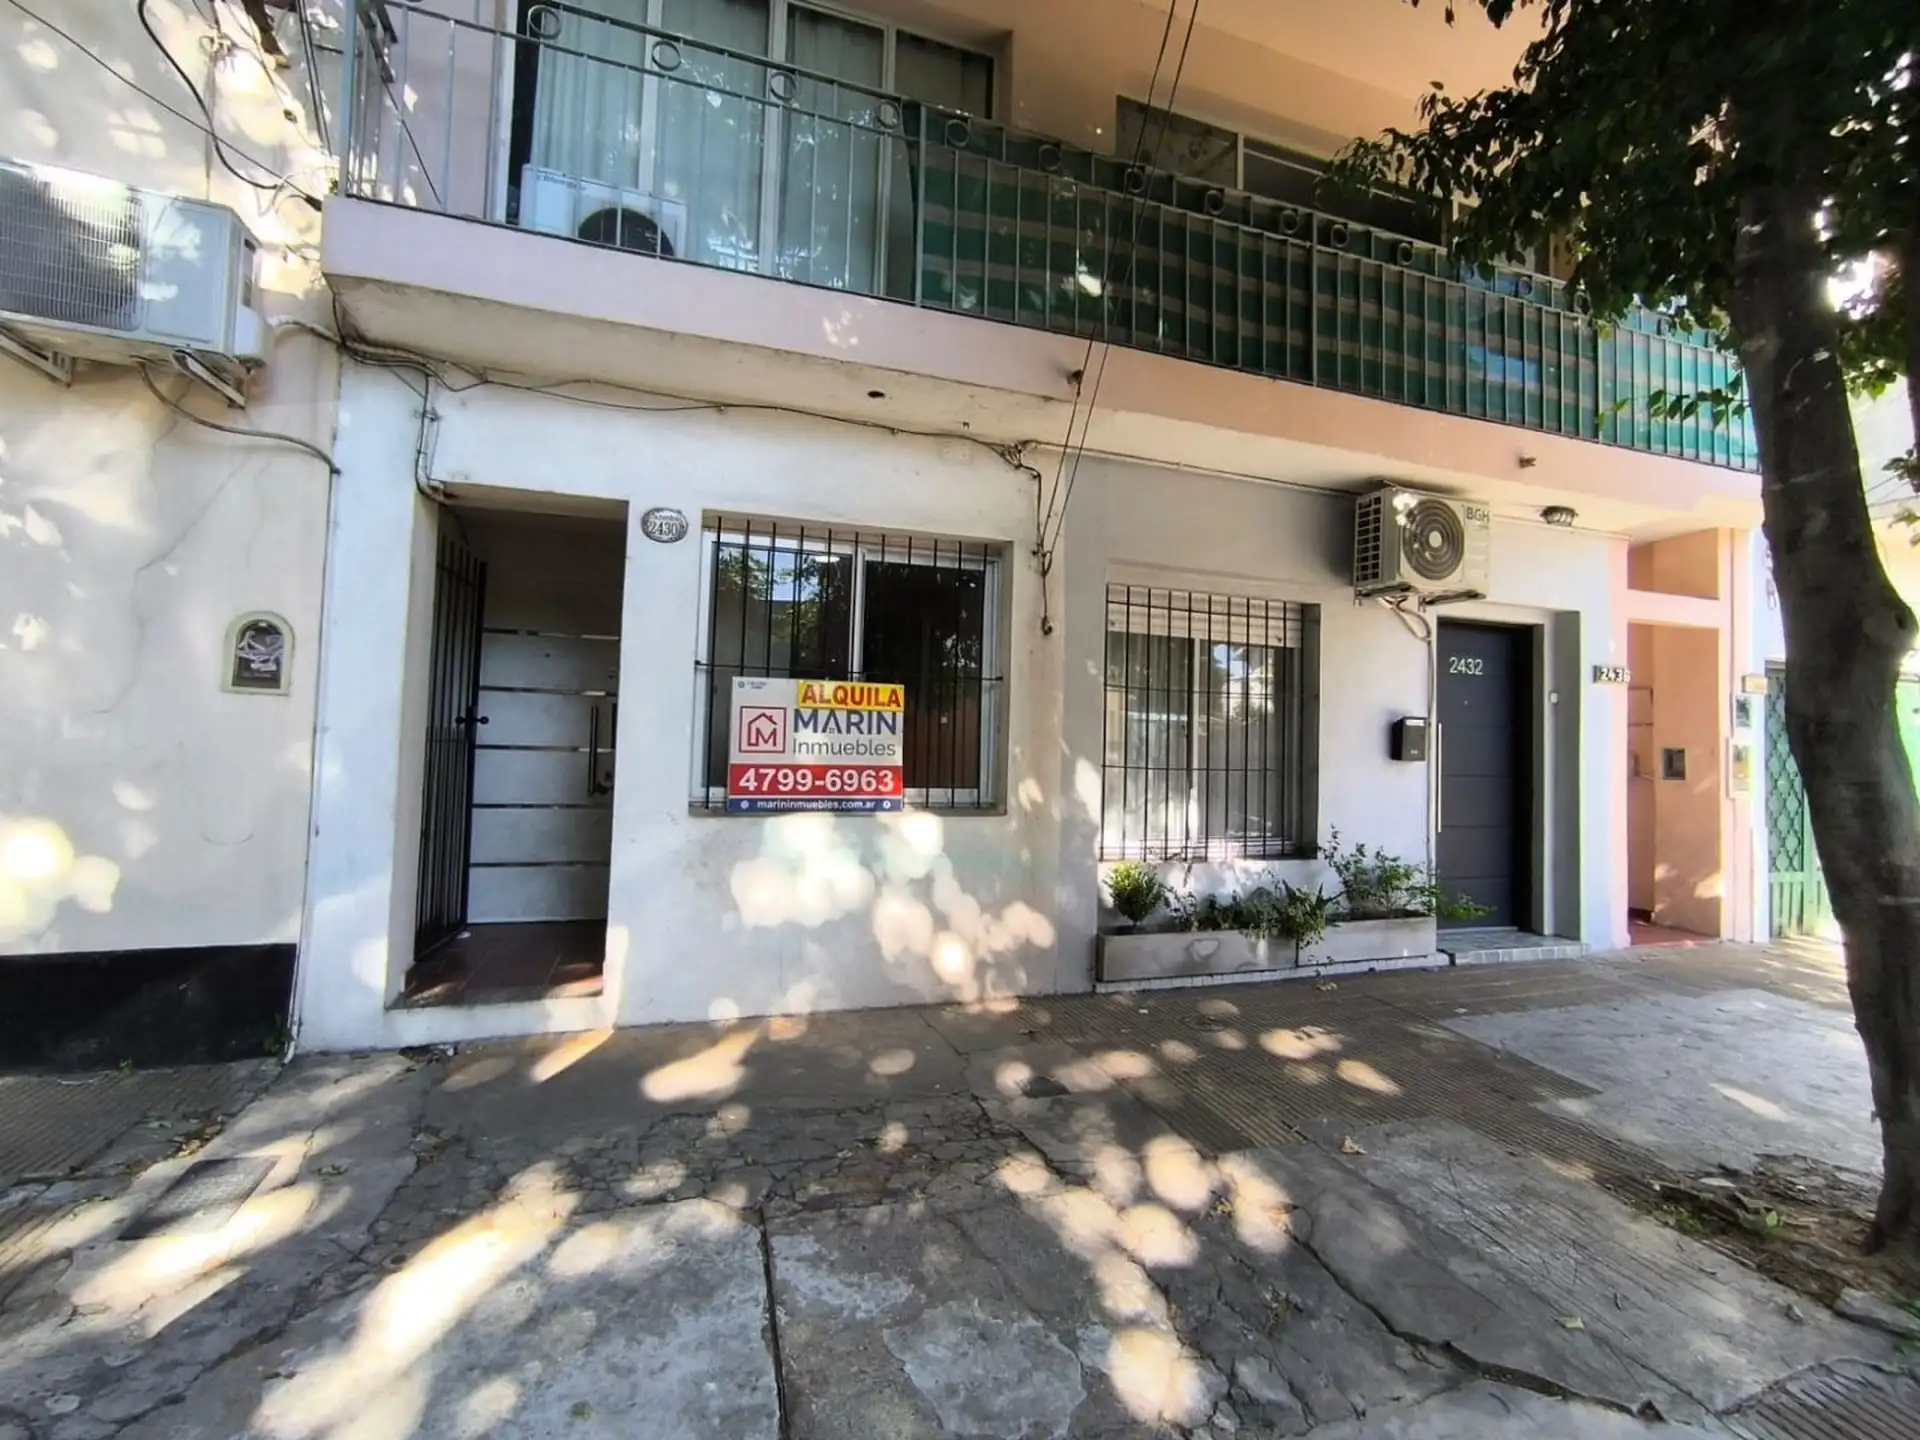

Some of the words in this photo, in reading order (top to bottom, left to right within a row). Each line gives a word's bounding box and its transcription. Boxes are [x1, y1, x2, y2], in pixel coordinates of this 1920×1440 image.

[1466, 506, 1490, 522] BGH
[647, 521, 678, 536] 2430
[1449, 656, 1483, 675] 2432
[801, 684, 902, 707] ALQUILA
[793, 708, 897, 735] MARIN
[792, 737, 896, 757] Inmuebles
[738, 767, 895, 792] 4799-6963
[756, 799, 876, 809] marininmuebles.com.ar
